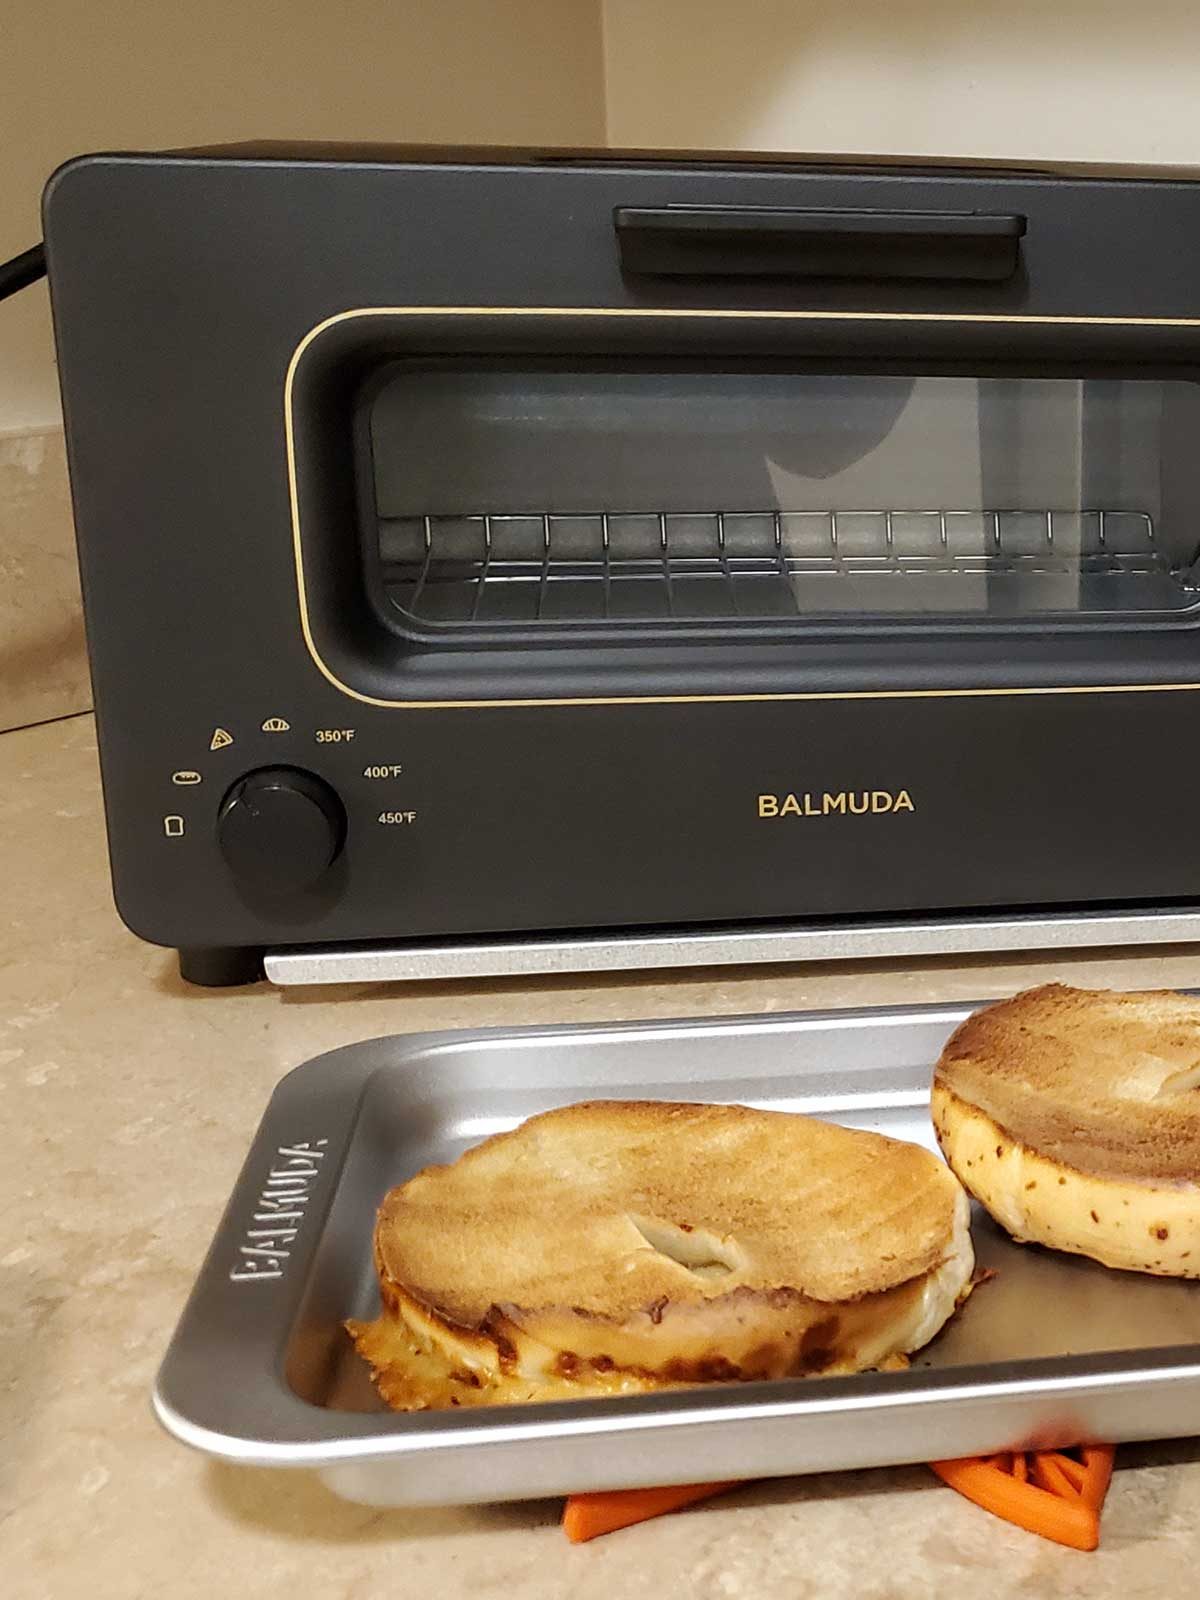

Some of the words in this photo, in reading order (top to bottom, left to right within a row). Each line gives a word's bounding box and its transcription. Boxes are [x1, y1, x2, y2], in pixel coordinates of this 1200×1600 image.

[315, 729, 356, 743] 350°F
[363, 765, 402, 779] 400°F
[758, 790, 915, 817] BALMUDA
[378, 811, 417, 825] 450°F
[229, 1138, 328, 1280] BALMUDA
